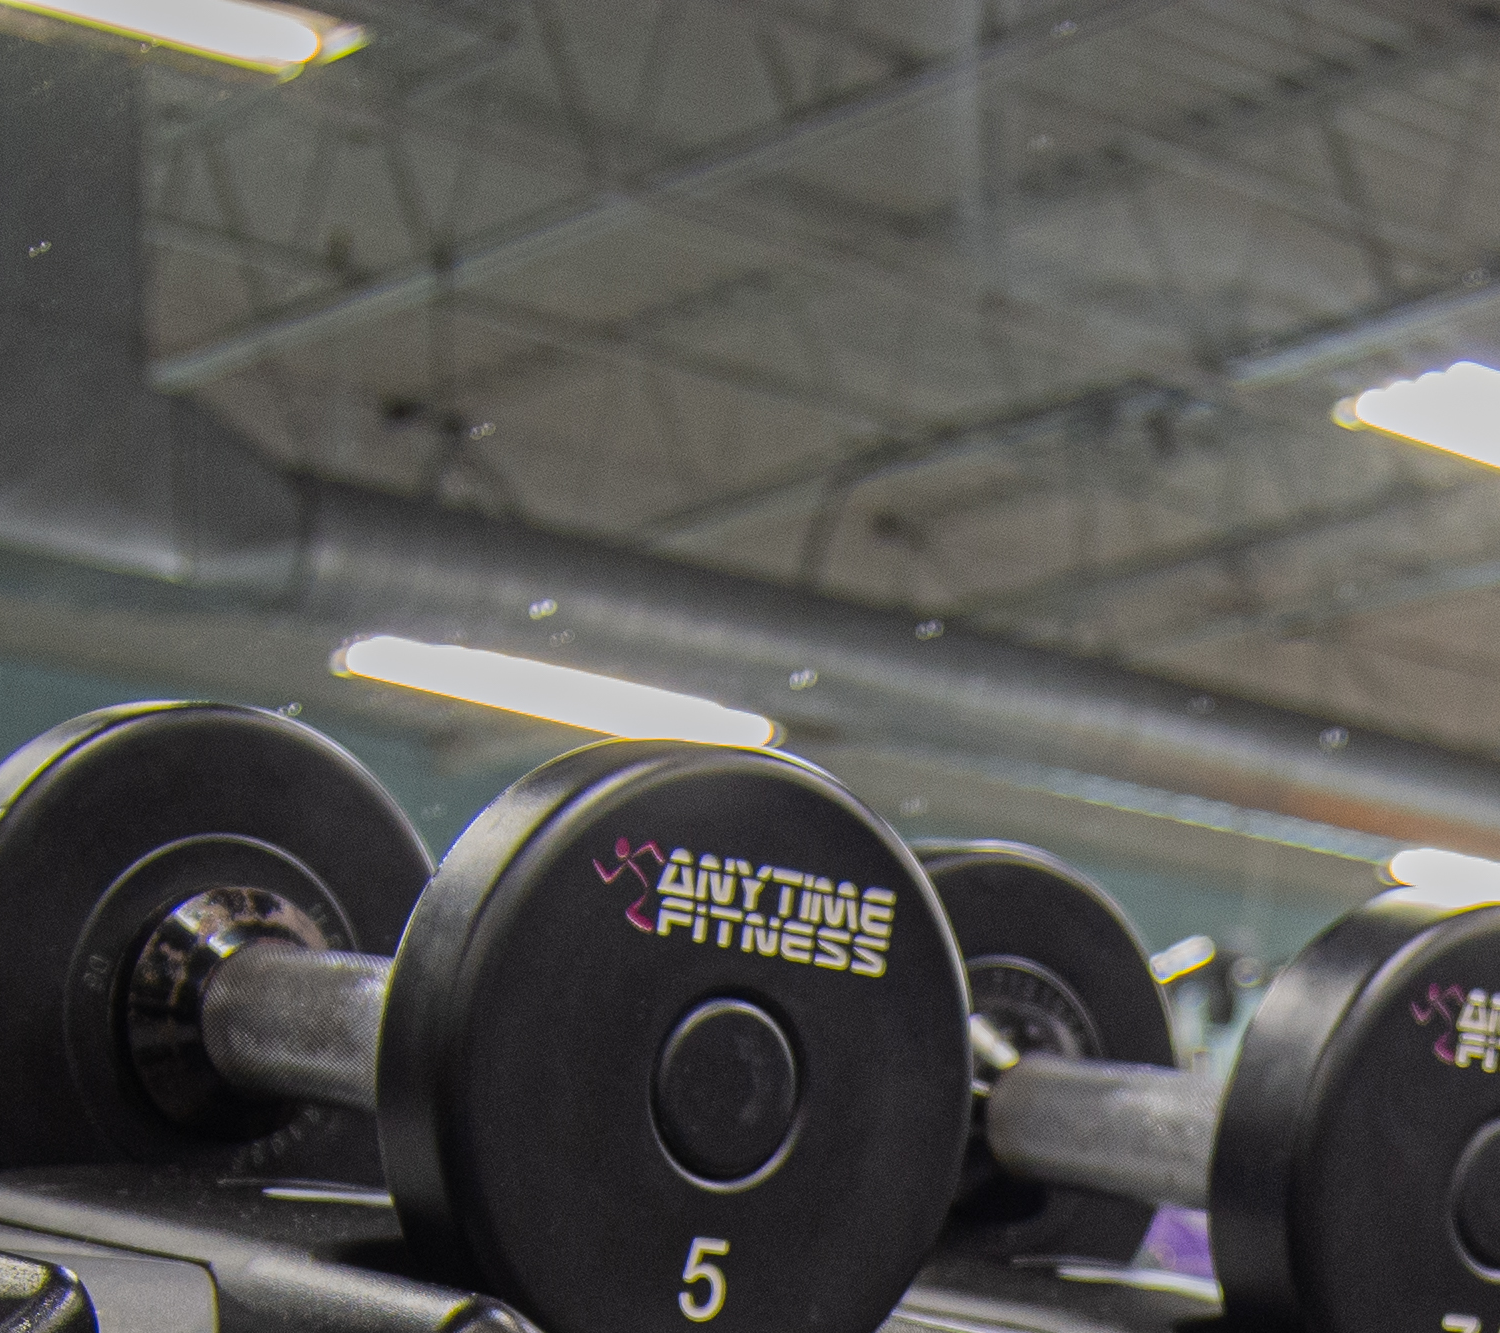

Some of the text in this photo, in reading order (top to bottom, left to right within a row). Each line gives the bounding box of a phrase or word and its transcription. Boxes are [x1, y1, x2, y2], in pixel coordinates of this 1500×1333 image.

[656, 847, 898, 938] ANYTIME
[656, 896, 891, 978] FITNESS
[678, 1236, 730, 1323] 5
